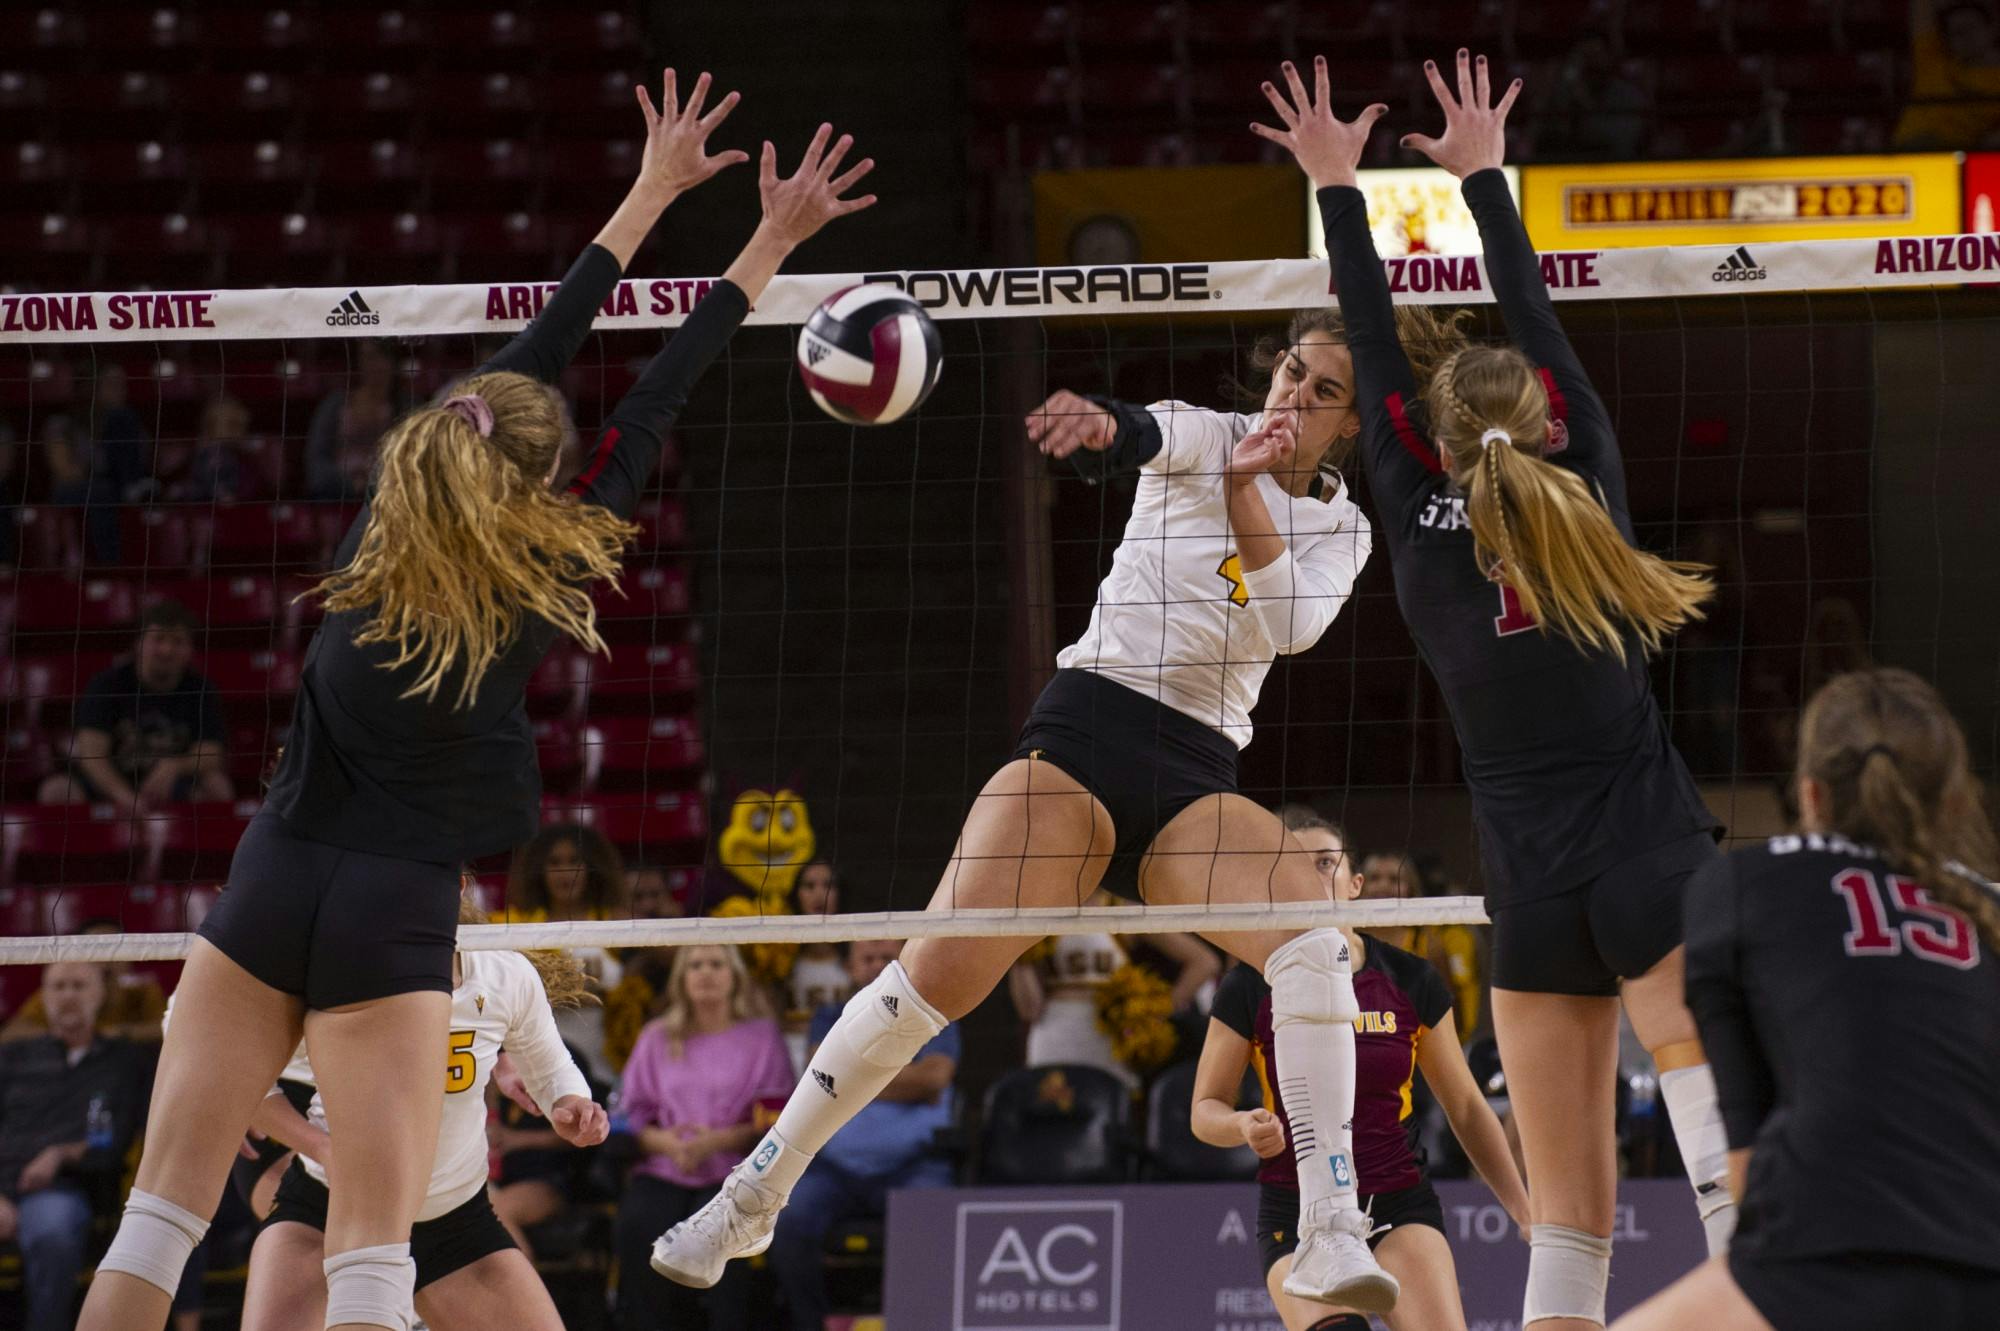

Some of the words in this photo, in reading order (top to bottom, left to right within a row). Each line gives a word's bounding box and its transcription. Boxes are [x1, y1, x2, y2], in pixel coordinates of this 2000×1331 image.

[1798, 183, 1906, 217] 2020
[1328, 257, 1482, 294] ZONA
[1540, 253, 1601, 288] ATE
[1712, 268, 1767, 282] adidas
[0, 297, 98, 331] ZONA
[108, 294, 215, 330] STATE
[326, 312, 380, 326] adidas
[1831, 867, 1980, 970] 15
[1216, 1209, 1248, 1244] A
[1452, 1204, 1509, 1244] TO
[978, 1225, 1098, 1285] AC
[976, 1289, 1099, 1311] HOTELS
